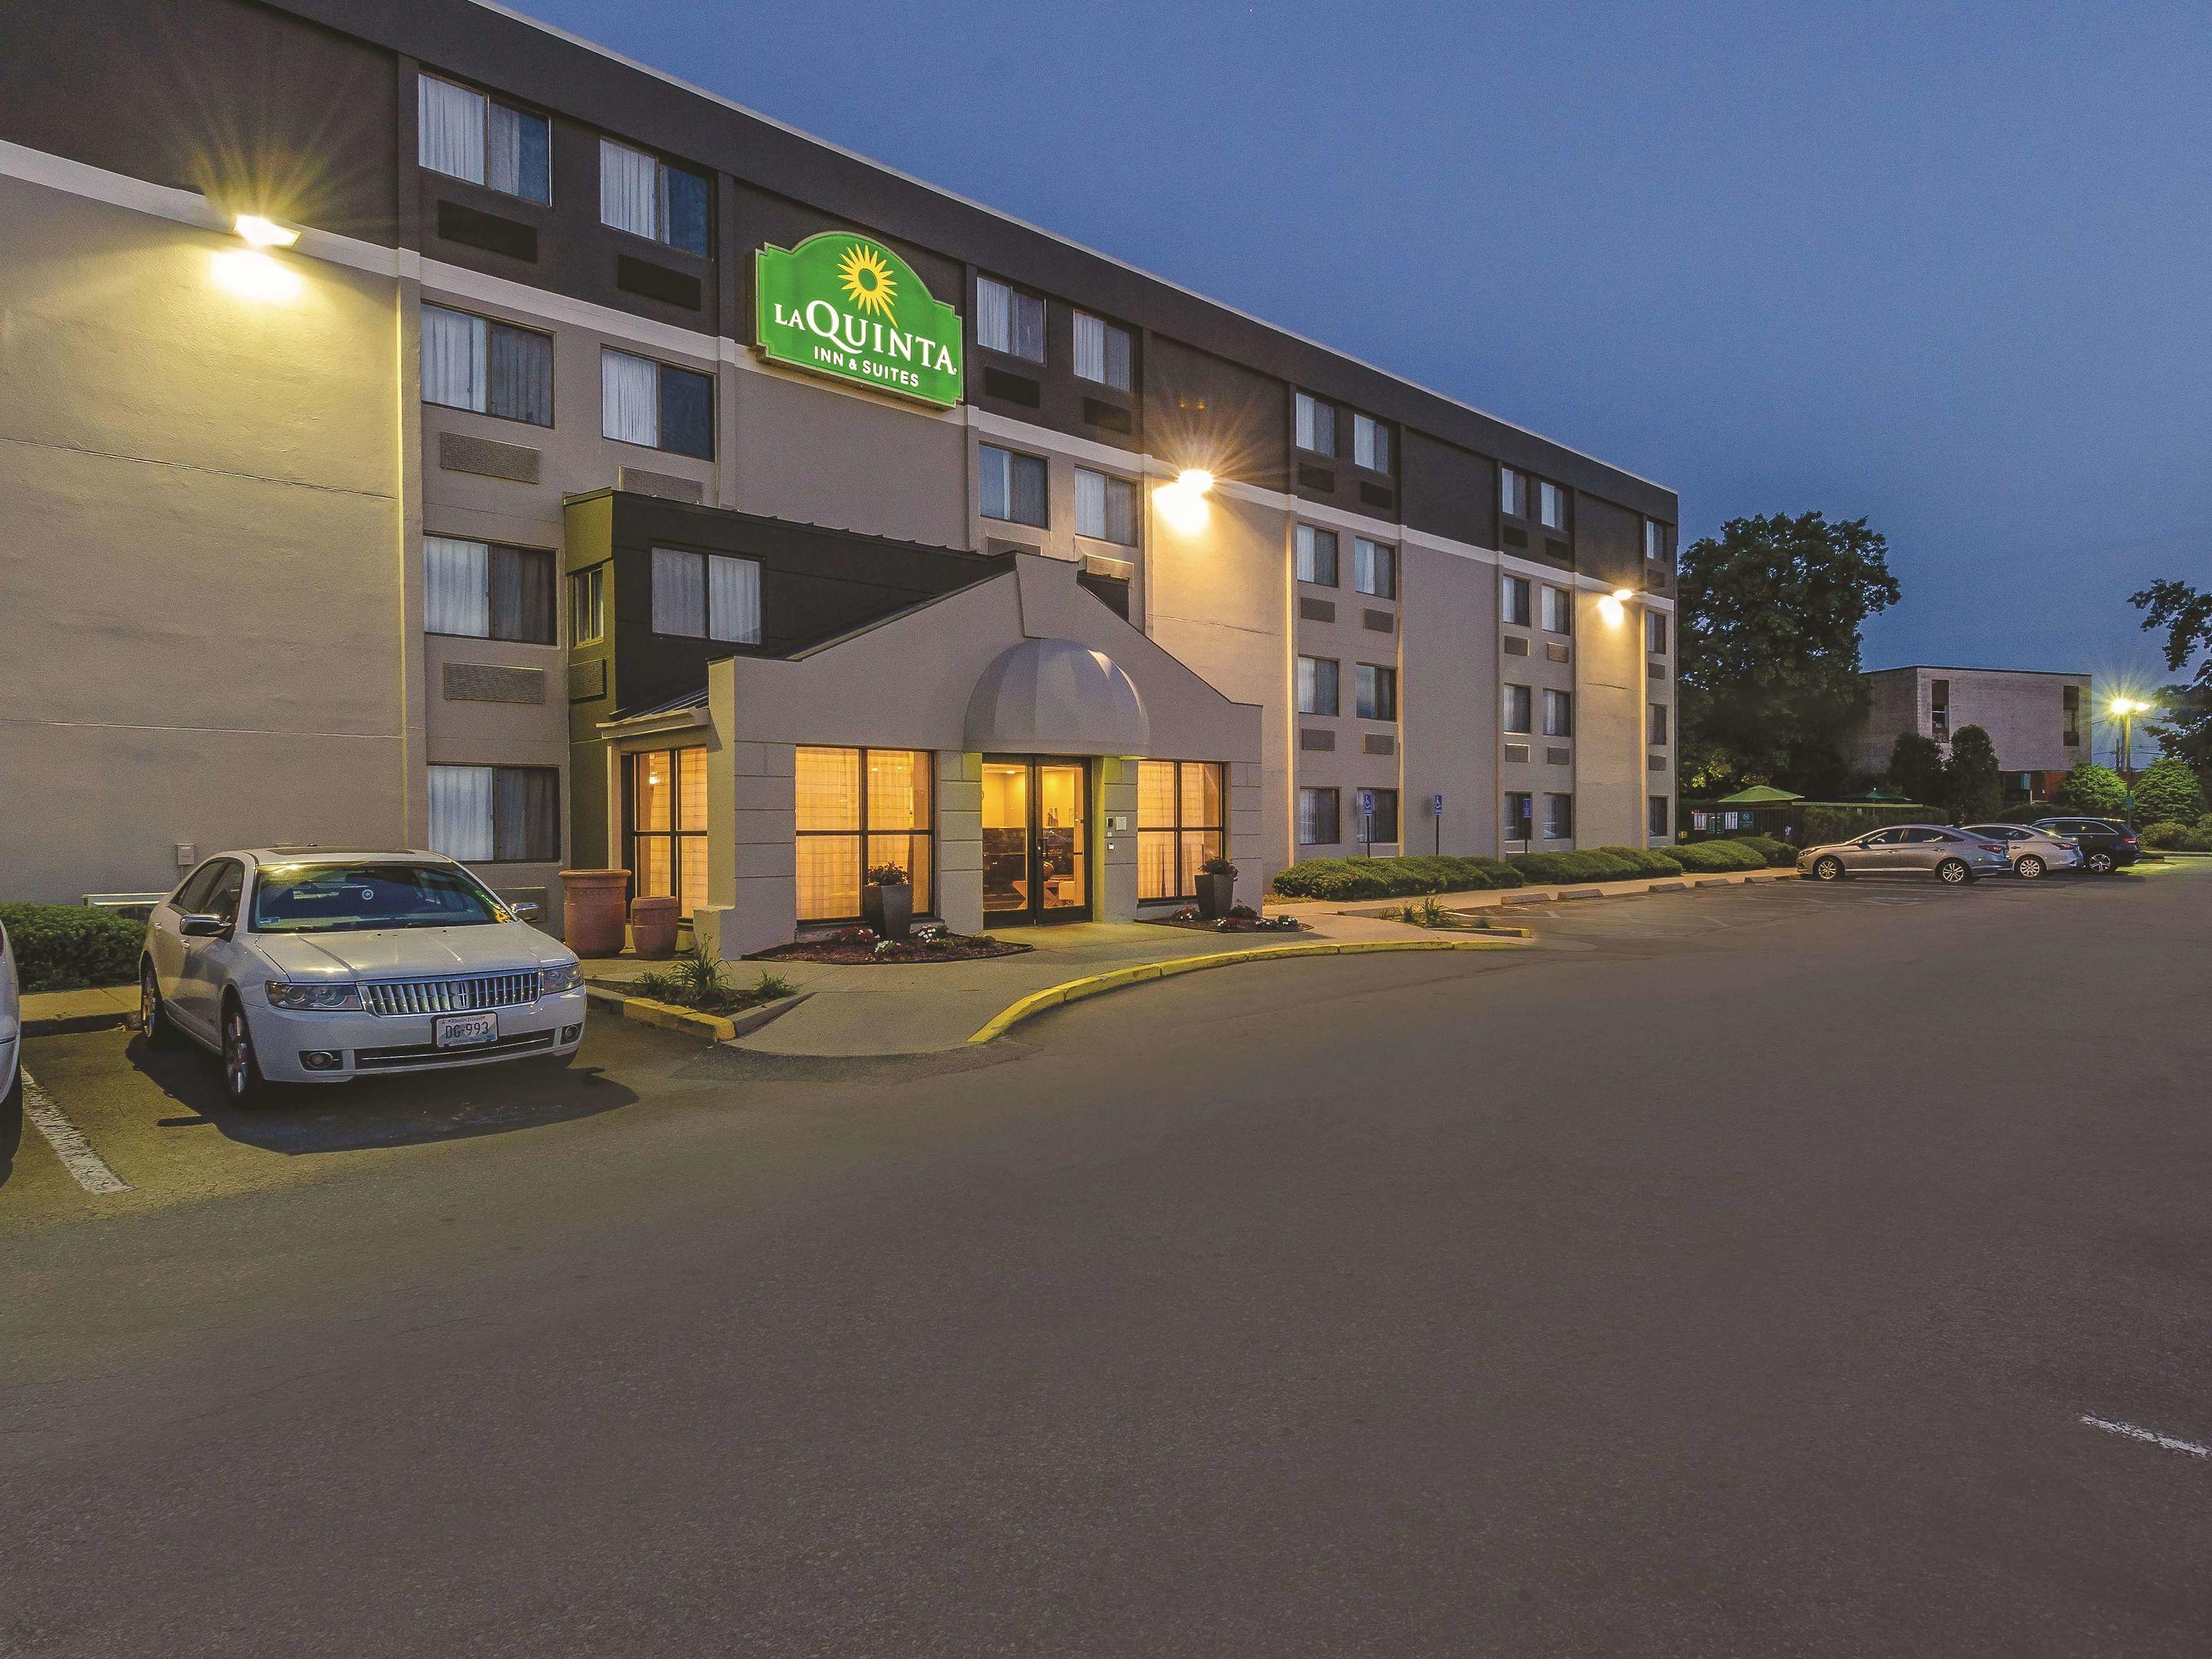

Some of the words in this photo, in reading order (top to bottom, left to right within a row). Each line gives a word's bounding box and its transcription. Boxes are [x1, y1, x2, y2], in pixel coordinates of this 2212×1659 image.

[814, 346, 843, 366] INN
[849, 358, 857, 371] &
[862, 359, 919, 387] SUITES
